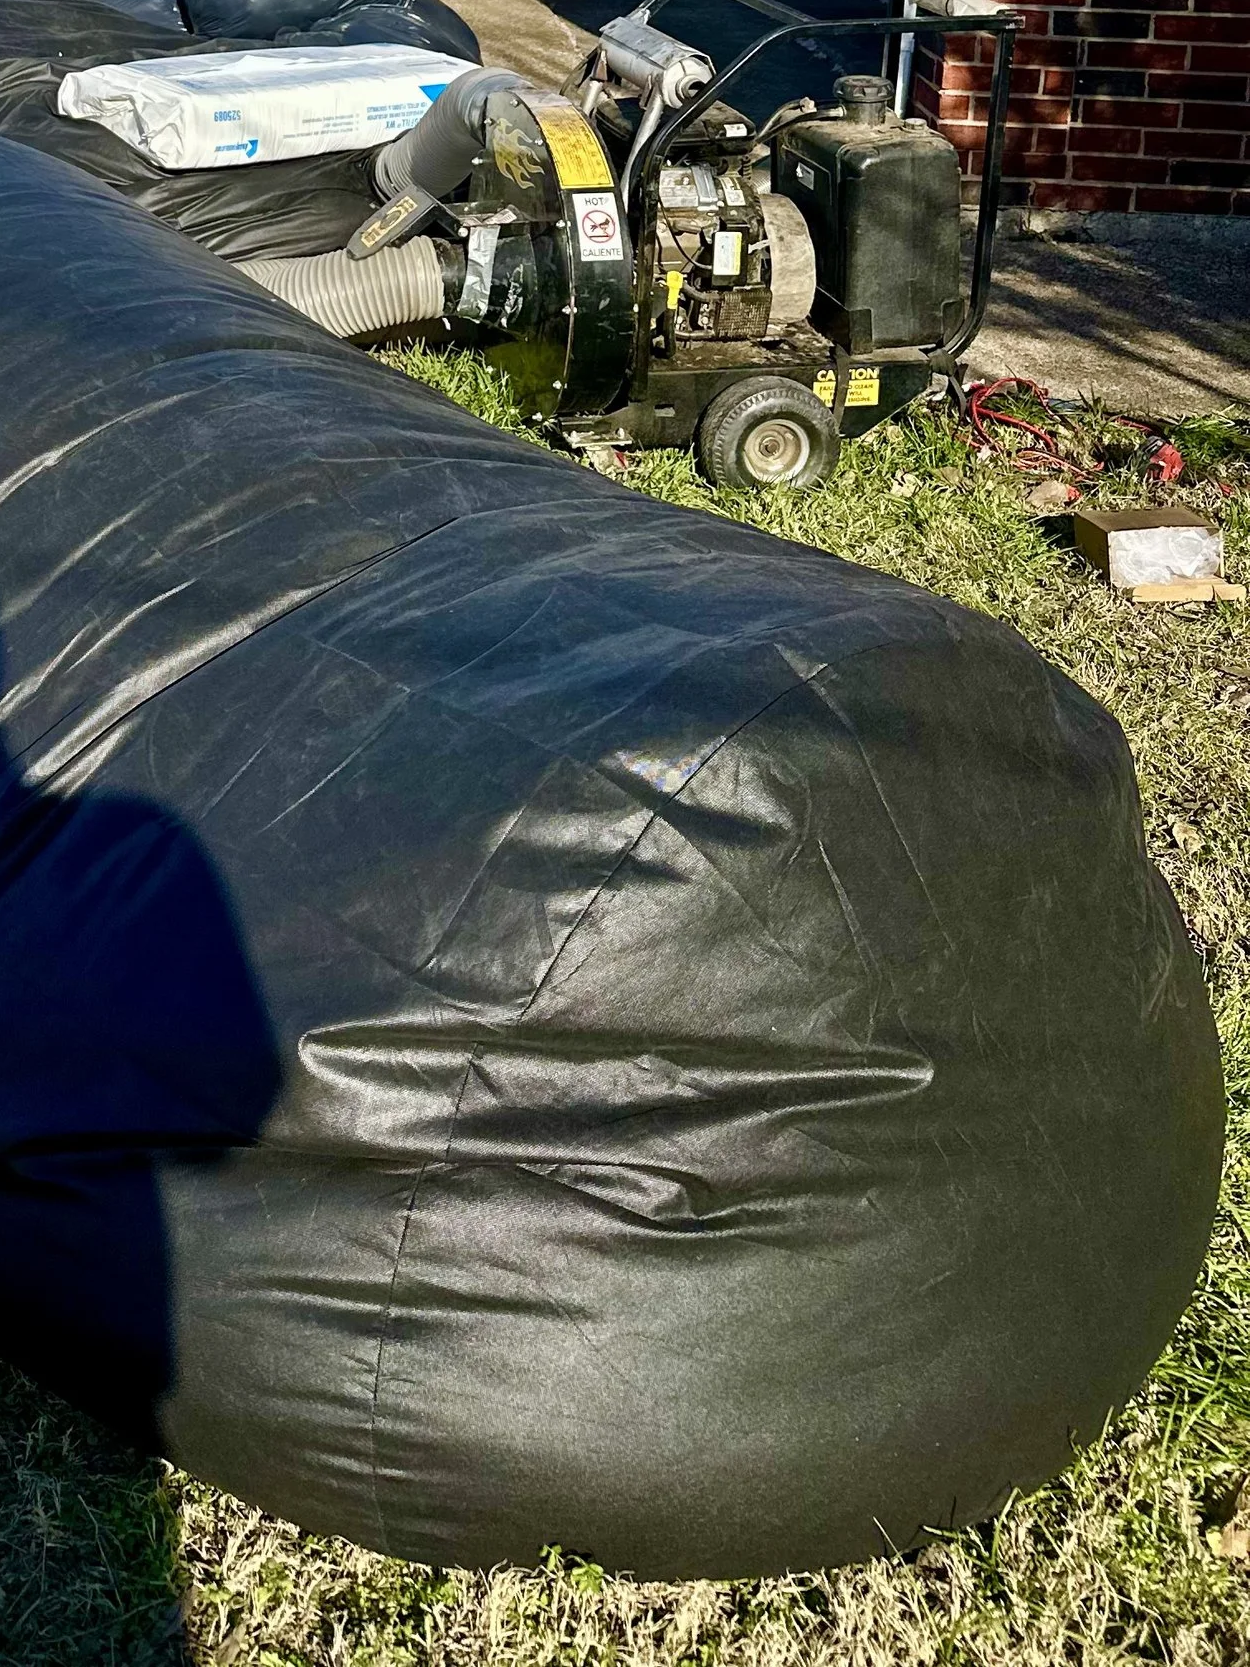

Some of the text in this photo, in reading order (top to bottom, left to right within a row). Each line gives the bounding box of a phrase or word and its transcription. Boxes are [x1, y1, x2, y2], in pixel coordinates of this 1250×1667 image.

[214, 110, 241, 122] 525089
[584, 197, 605, 206] HOT
[582, 247, 622, 258] CALIENTE
[816, 367, 880, 382] CAION
